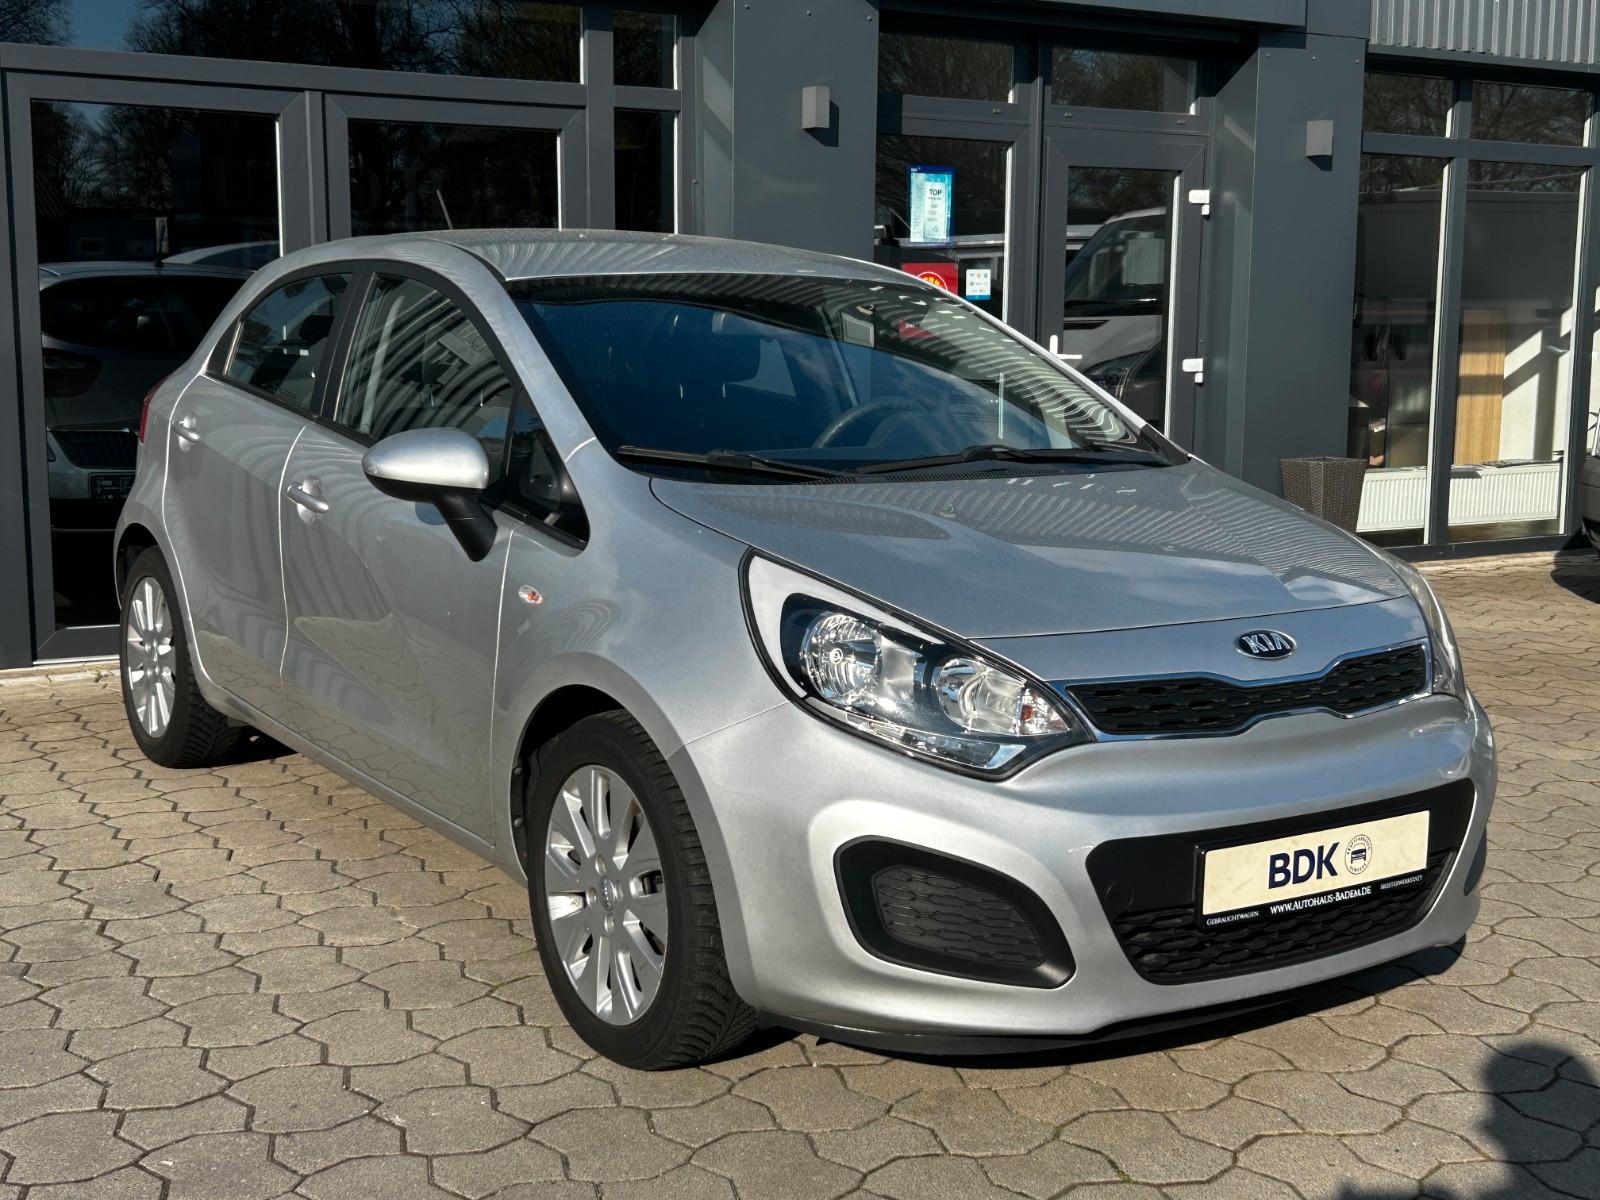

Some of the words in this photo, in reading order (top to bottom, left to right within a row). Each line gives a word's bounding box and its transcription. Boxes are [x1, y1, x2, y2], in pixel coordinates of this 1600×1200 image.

[929, 188, 942, 196] TOP
[1242, 632, 1291, 653] KIA
[1268, 841, 1340, 889] BDK
